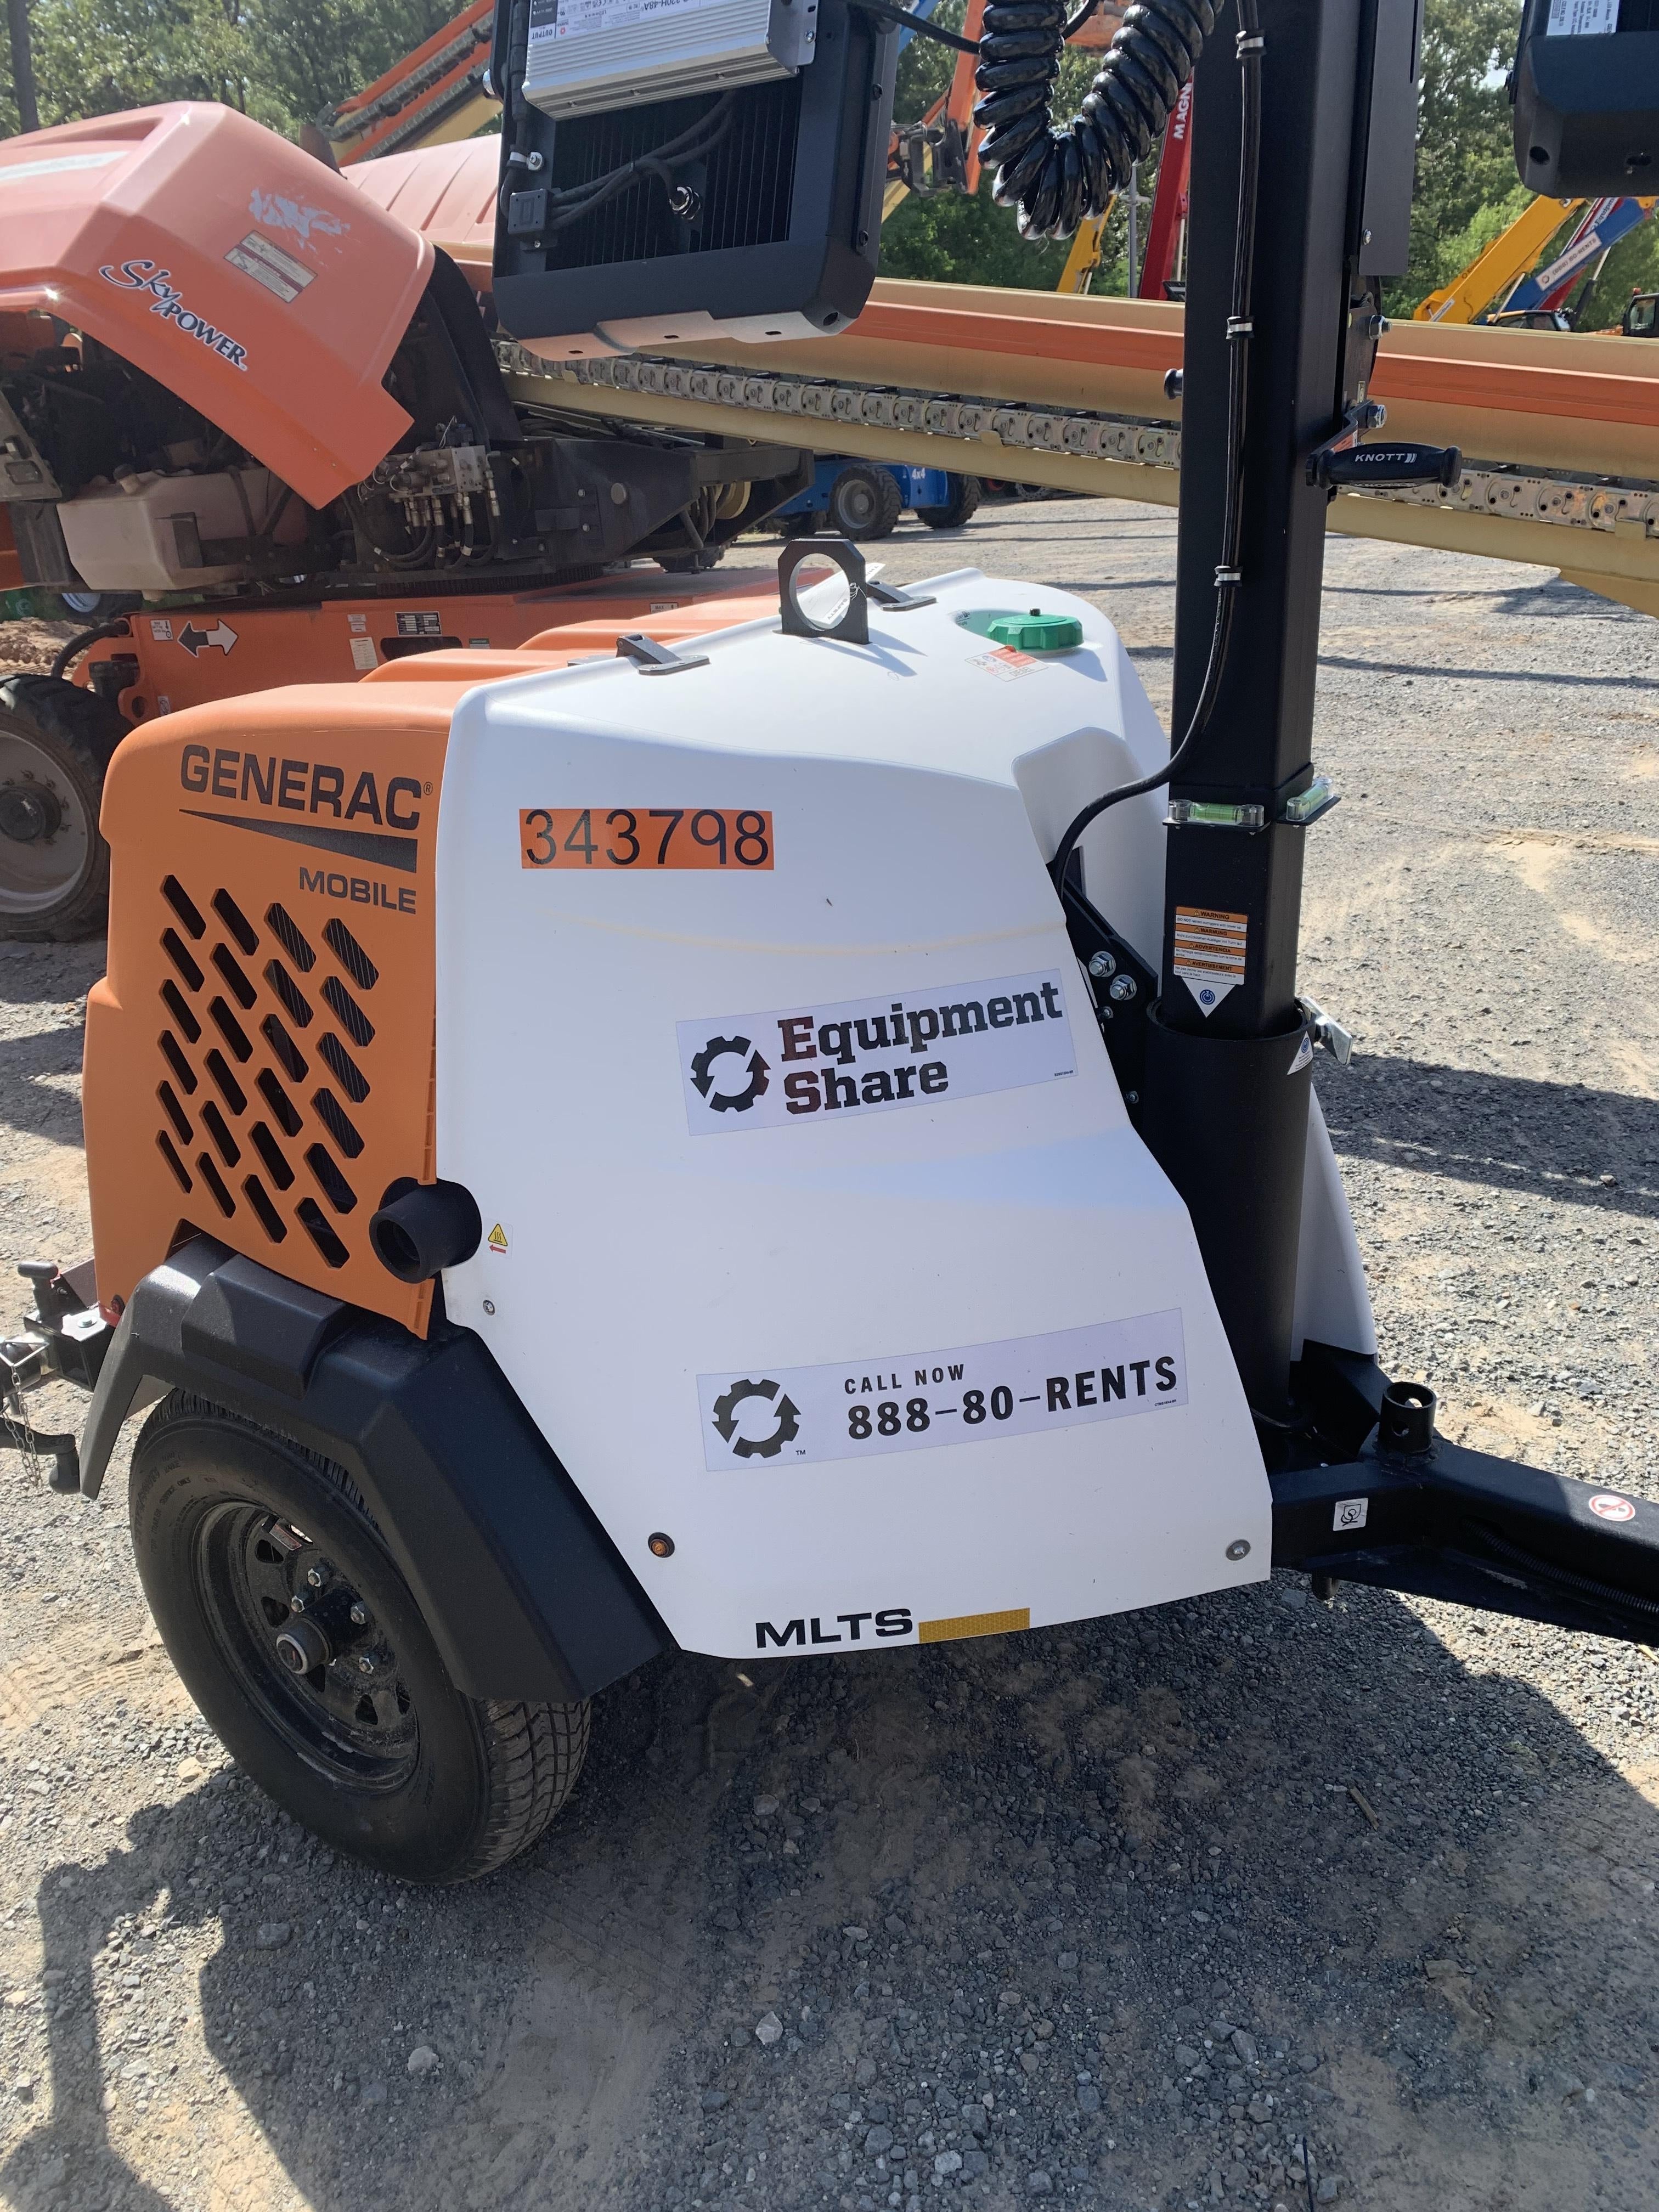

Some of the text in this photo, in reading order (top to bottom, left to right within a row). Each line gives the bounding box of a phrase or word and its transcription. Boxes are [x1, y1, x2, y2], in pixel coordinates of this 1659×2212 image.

[532, 29, 553, 39] OUTPUT
[1355, 453, 1406, 462] KNOTT
[828, 598, 848, 620] SAFETY
[526, 809, 769, 866] 343798
[299, 866, 416, 915] MOBILE
[1200, 911, 1229, 919] WARNING
[1200, 928, 1227, 936] WARNUNG
[1195, 944, 1231, 953] ADVERTENCIA
[1192, 961, 1233, 971] AVERTISSEMENT
[777, 982, 1063, 1065] Equipment
[783, 1061, 949, 1115] Share
[844, 1364, 966, 1395] CALL NOW
[847, 1356, 1177, 1440] 888-80-RENTS
[755, 1608, 913, 1649] MLTS
